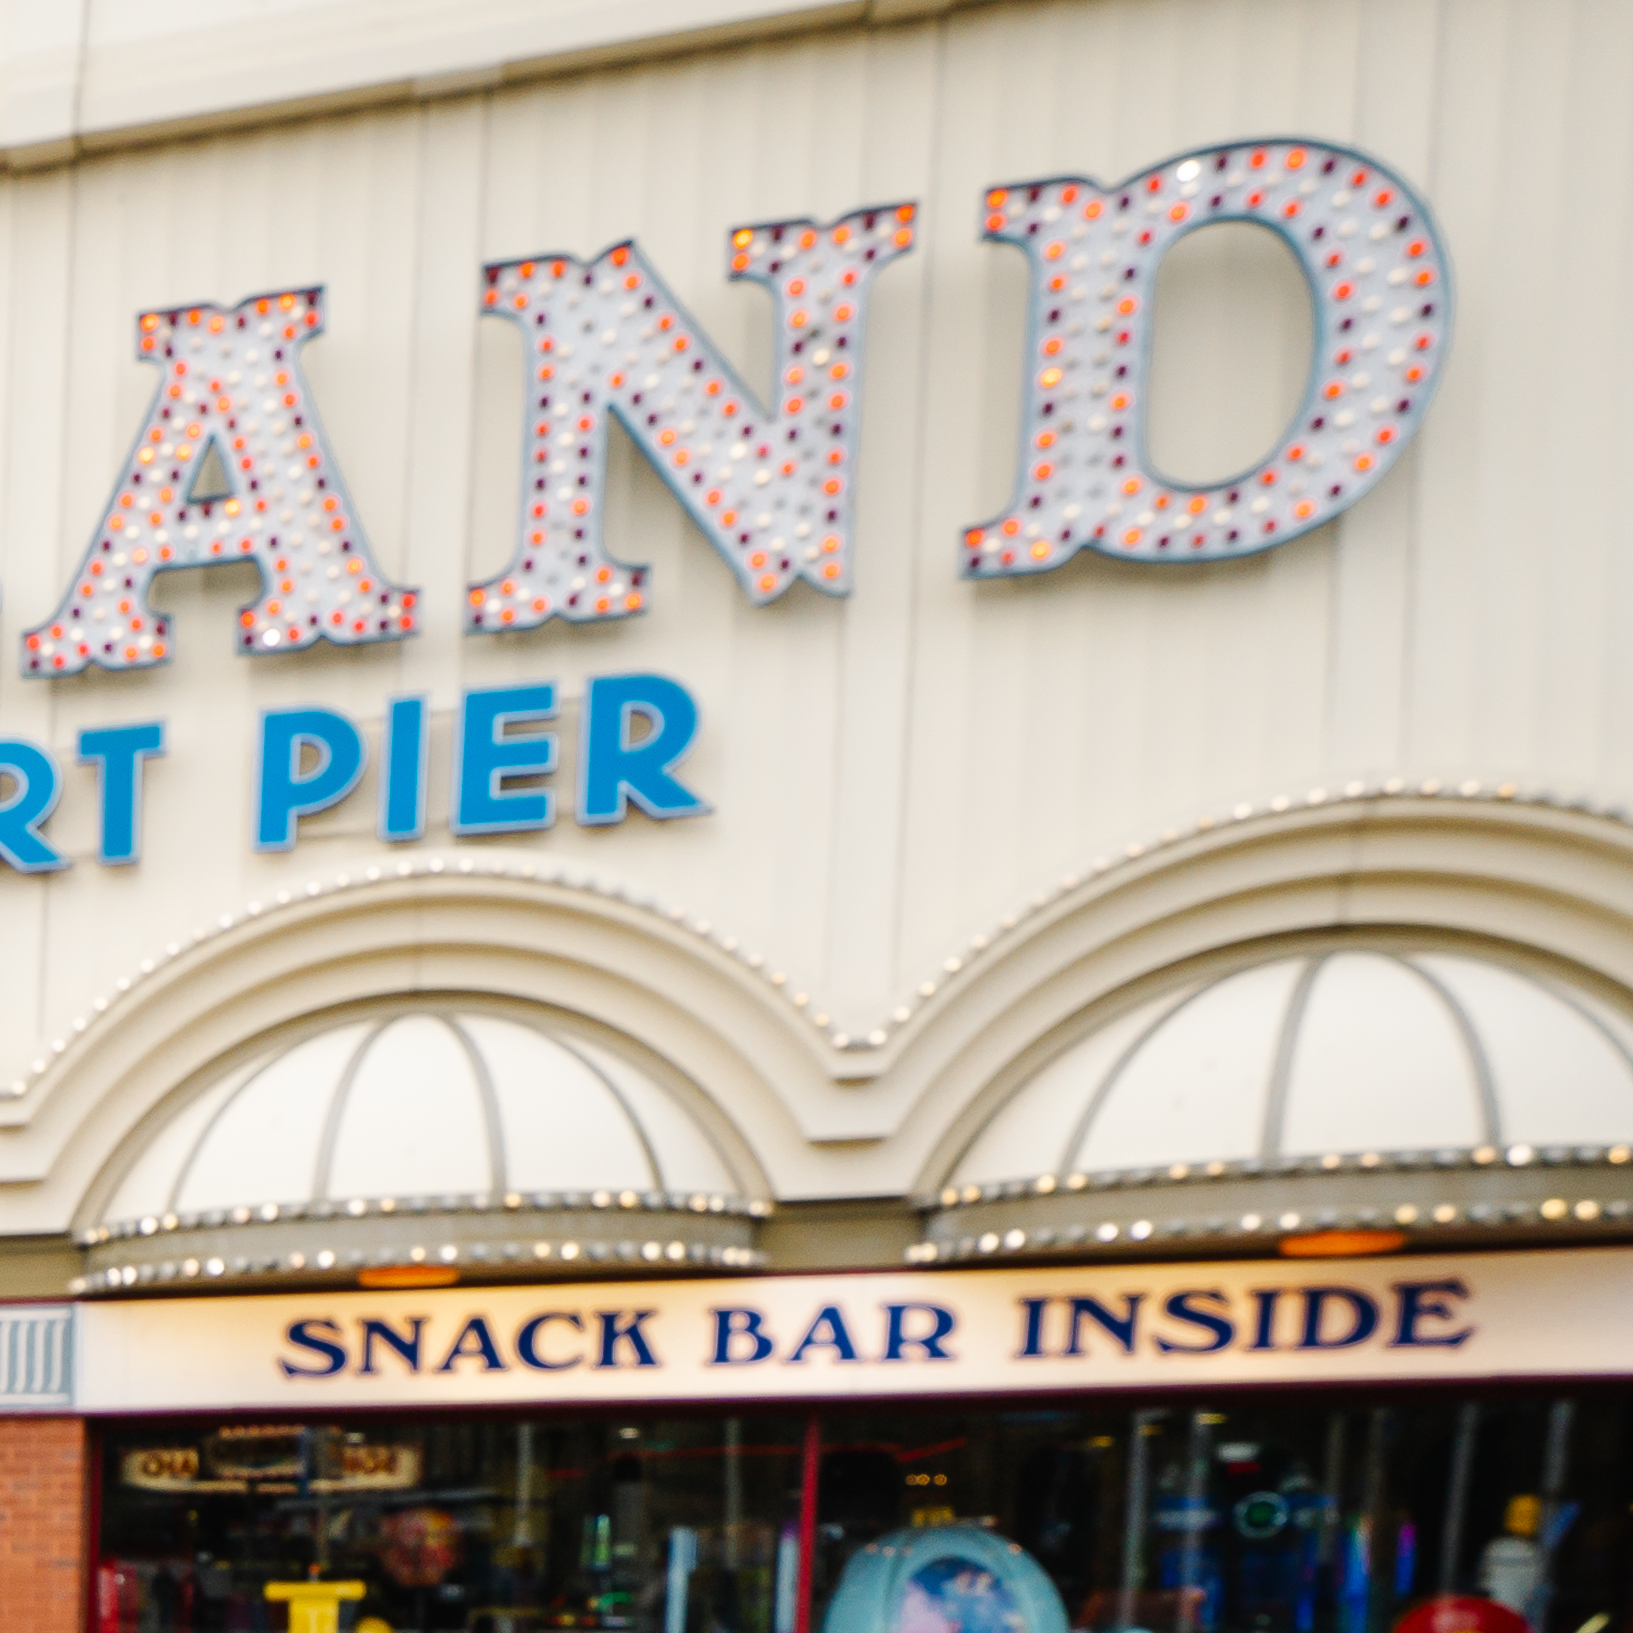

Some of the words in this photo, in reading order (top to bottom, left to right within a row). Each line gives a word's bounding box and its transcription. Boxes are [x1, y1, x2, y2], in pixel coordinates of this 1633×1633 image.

[254, 670, 714, 852] PIER
[277, 1307, 662, 1381] SNACK
[708, 1302, 960, 1366] BAR
[1014, 1280, 1476, 1360] INSIDE
